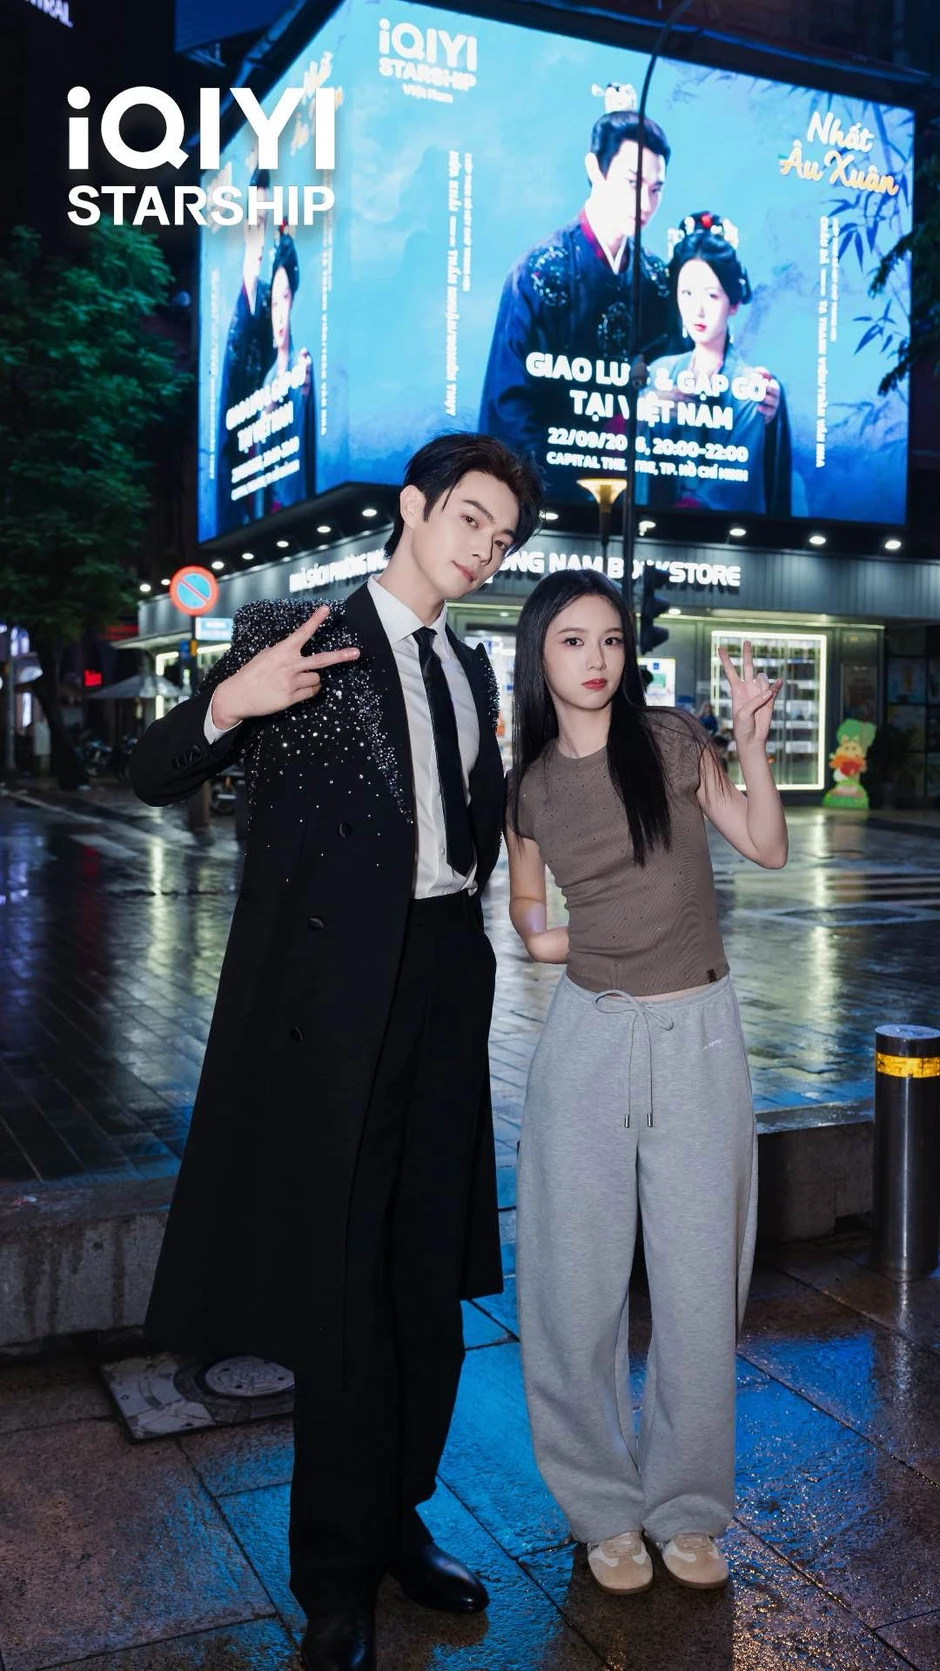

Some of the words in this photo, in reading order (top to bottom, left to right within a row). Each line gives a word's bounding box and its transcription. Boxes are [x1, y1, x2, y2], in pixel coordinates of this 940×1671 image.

[379, 18, 477, 72] iQIYI
[379, 57, 477, 91] STARSHIP
[806, 111, 875, 153] Nhất
[780, 140, 824, 181] Âu
[824, 150, 899, 195] Xuân
[526, 352, 593, 382] GIAO
[596, 360, 650, 387] LƯ
[570, 389, 614, 422] TẠI
[677, 402, 733, 430] NAM
[546, 451, 600, 469] CAPITAL
[548, 553, 603, 574] NAM
